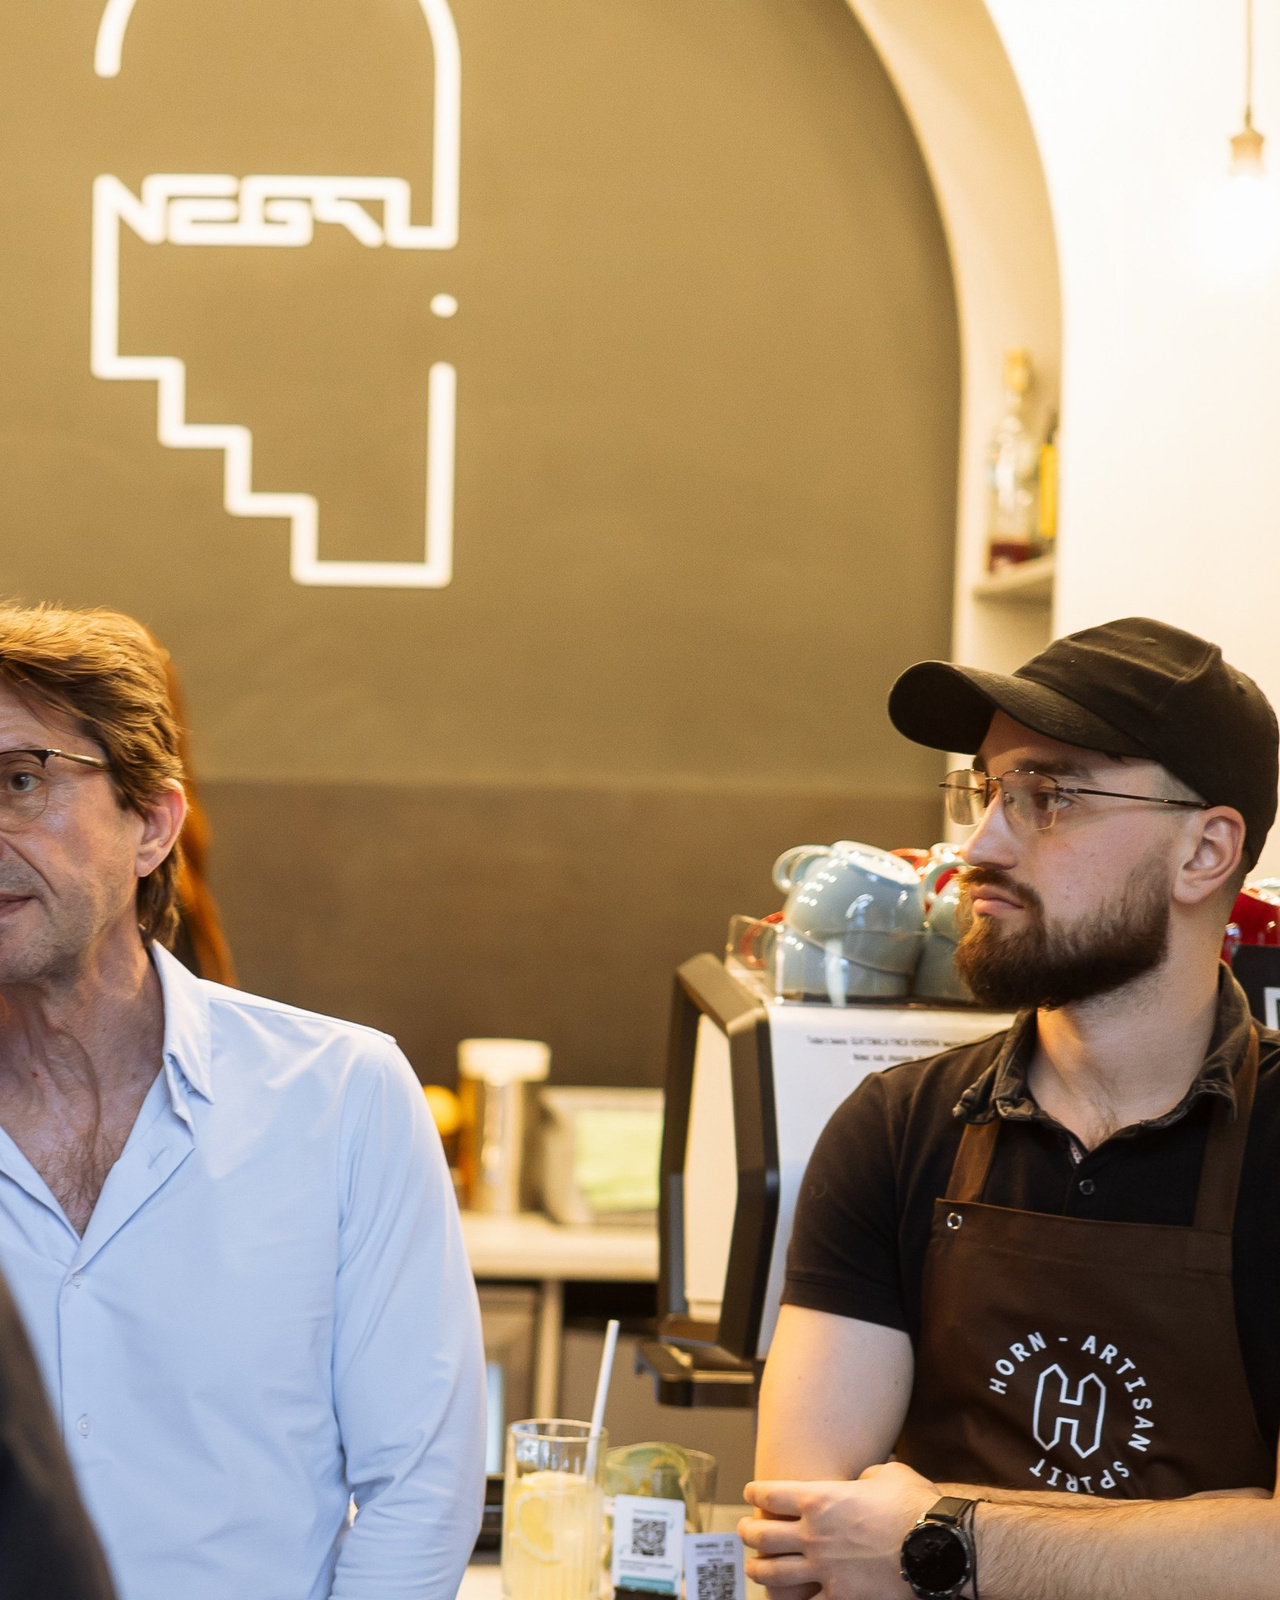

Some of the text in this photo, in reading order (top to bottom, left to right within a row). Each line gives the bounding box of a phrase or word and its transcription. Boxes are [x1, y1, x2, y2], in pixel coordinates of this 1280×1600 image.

[989, 1332, 1047, 1395] HORN
[1081, 1335, 1155, 1452] ARTISAN
[1029, 1458, 1130, 1494] SPIRIT
